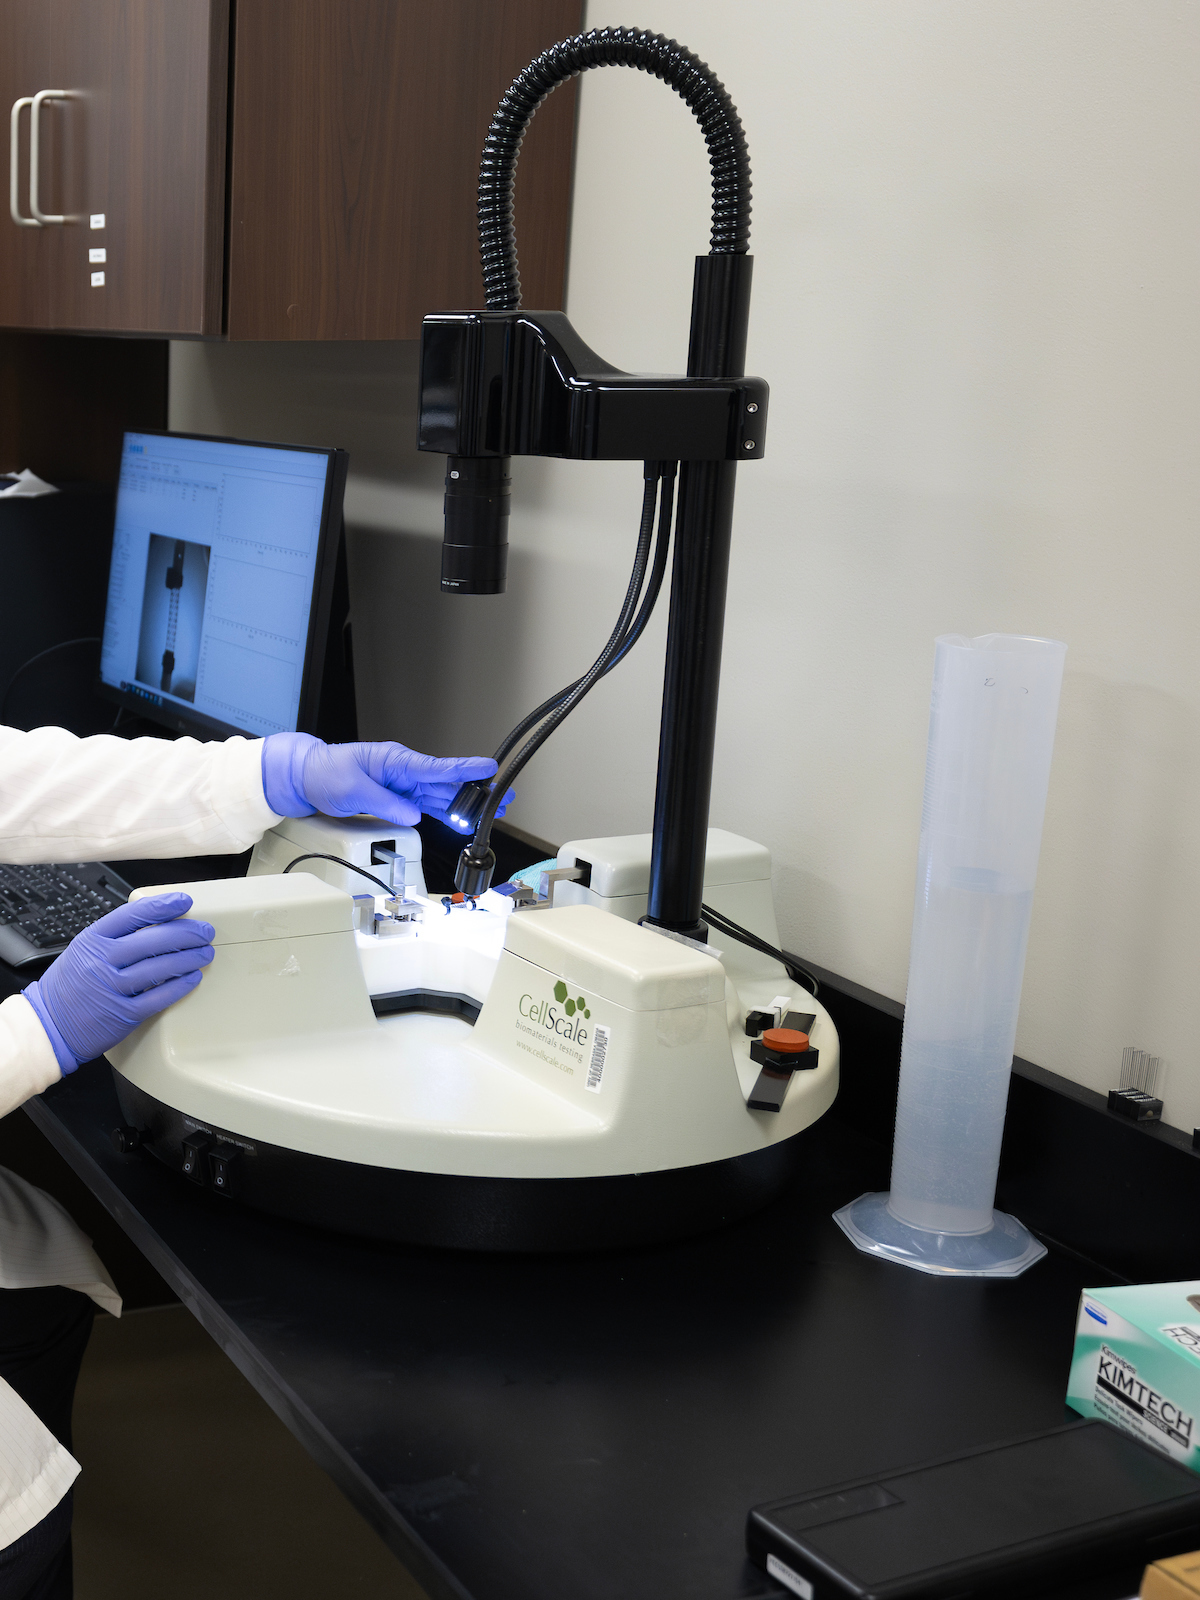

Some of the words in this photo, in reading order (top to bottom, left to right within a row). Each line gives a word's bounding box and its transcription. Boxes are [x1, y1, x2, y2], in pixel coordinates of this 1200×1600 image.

[515, 1019, 557, 1048] biomaterials
[559, 1043, 584, 1064] testing
[519, 993, 588, 1046] CellScale
[516, 1040, 574, 1076] www.cellscale.com
[1099, 1355, 1193, 1437] KIMTECH
